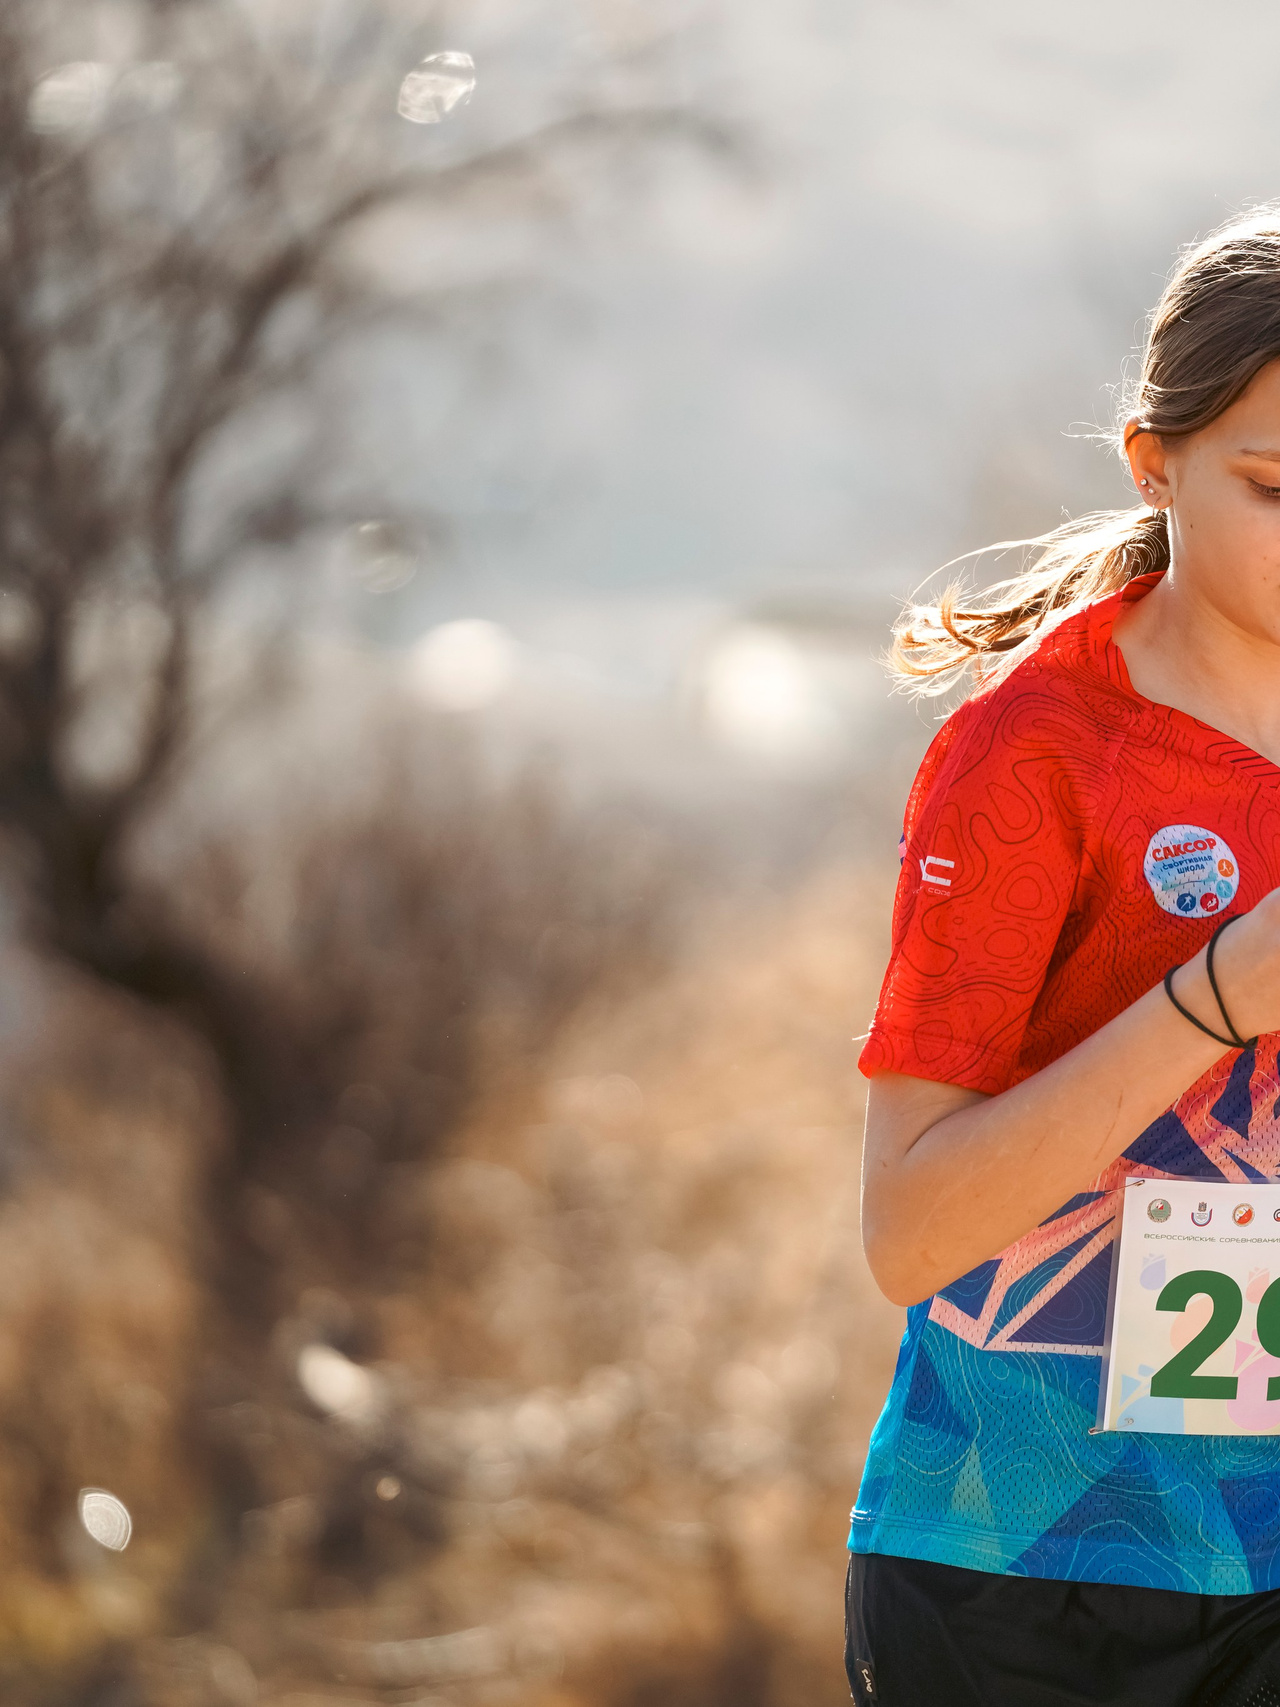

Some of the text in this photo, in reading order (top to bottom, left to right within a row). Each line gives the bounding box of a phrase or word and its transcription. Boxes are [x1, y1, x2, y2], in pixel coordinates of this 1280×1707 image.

[1152, 838, 1216, 862] САКСОР
[1162, 856, 1212, 870] СПОРТИВНАЯ
[1178, 864, 1206, 874] ШКОЛА
[1144, 1234, 1216, 1242] ВСЕРОССИЙСКИЕ
